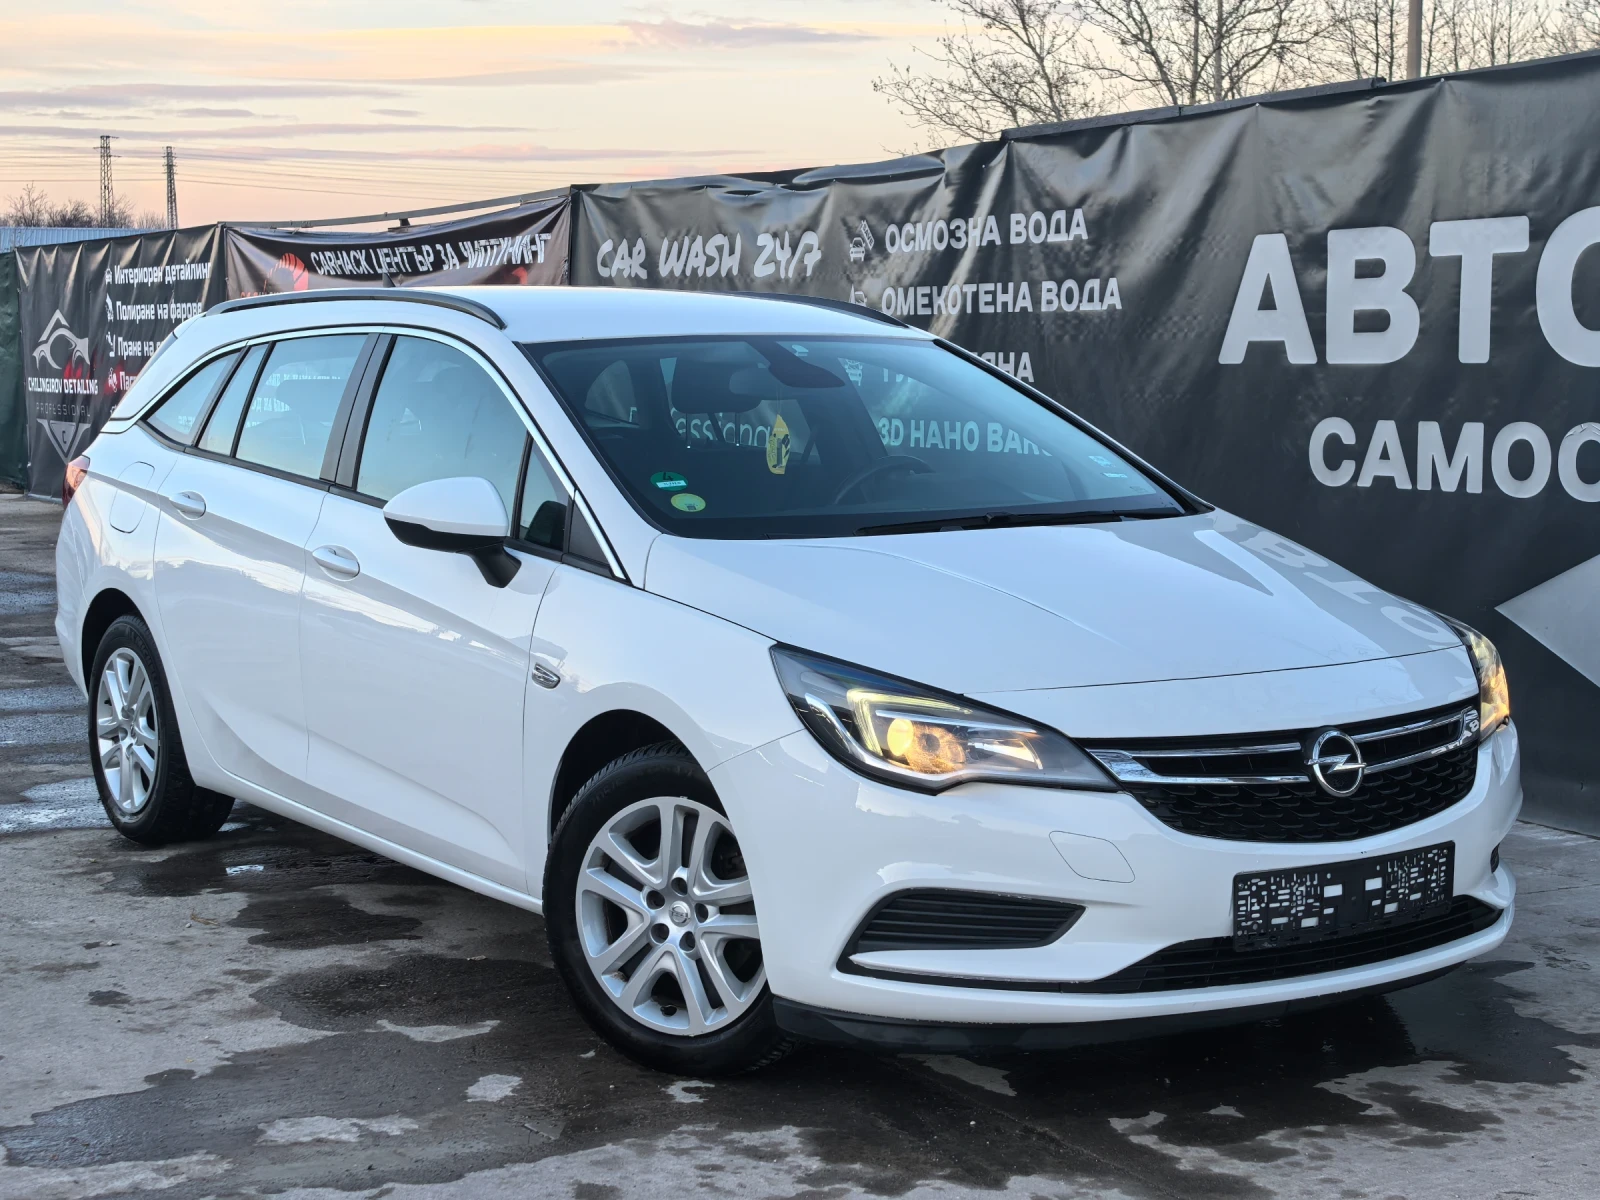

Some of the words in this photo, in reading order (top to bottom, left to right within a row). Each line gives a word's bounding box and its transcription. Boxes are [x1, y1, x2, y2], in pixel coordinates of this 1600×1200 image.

[885, 216, 1000, 254] ОСМОЗНА
[1009, 208, 1089, 246] ВОДА
[310, 249, 374, 276] CARHACK
[435, 242, 460, 271] ЗА
[597, 237, 648, 279] CAR
[658, 233, 742, 278] WASH
[753, 230, 822, 280] 24/7
[114, 265, 163, 287] Интериорен
[165, 258, 211, 284] детайлинг
[116, 301, 155, 324] Полиране
[157, 304, 168, 319] на
[881, 283, 1032, 317] ОМЕКОТЕНА
[1040, 277, 1122, 312] ВОДА
[117, 337, 142, 360] Пране
[144, 341, 155, 357] на
[28, 377, 63, 394] CHILINGIROV
[63, 378, 99, 395] DETAILING
[35, 402, 91, 417] PROFESSIONAL
[878, 417, 904, 447] 3D
[910, 419, 980, 452] НАНО
